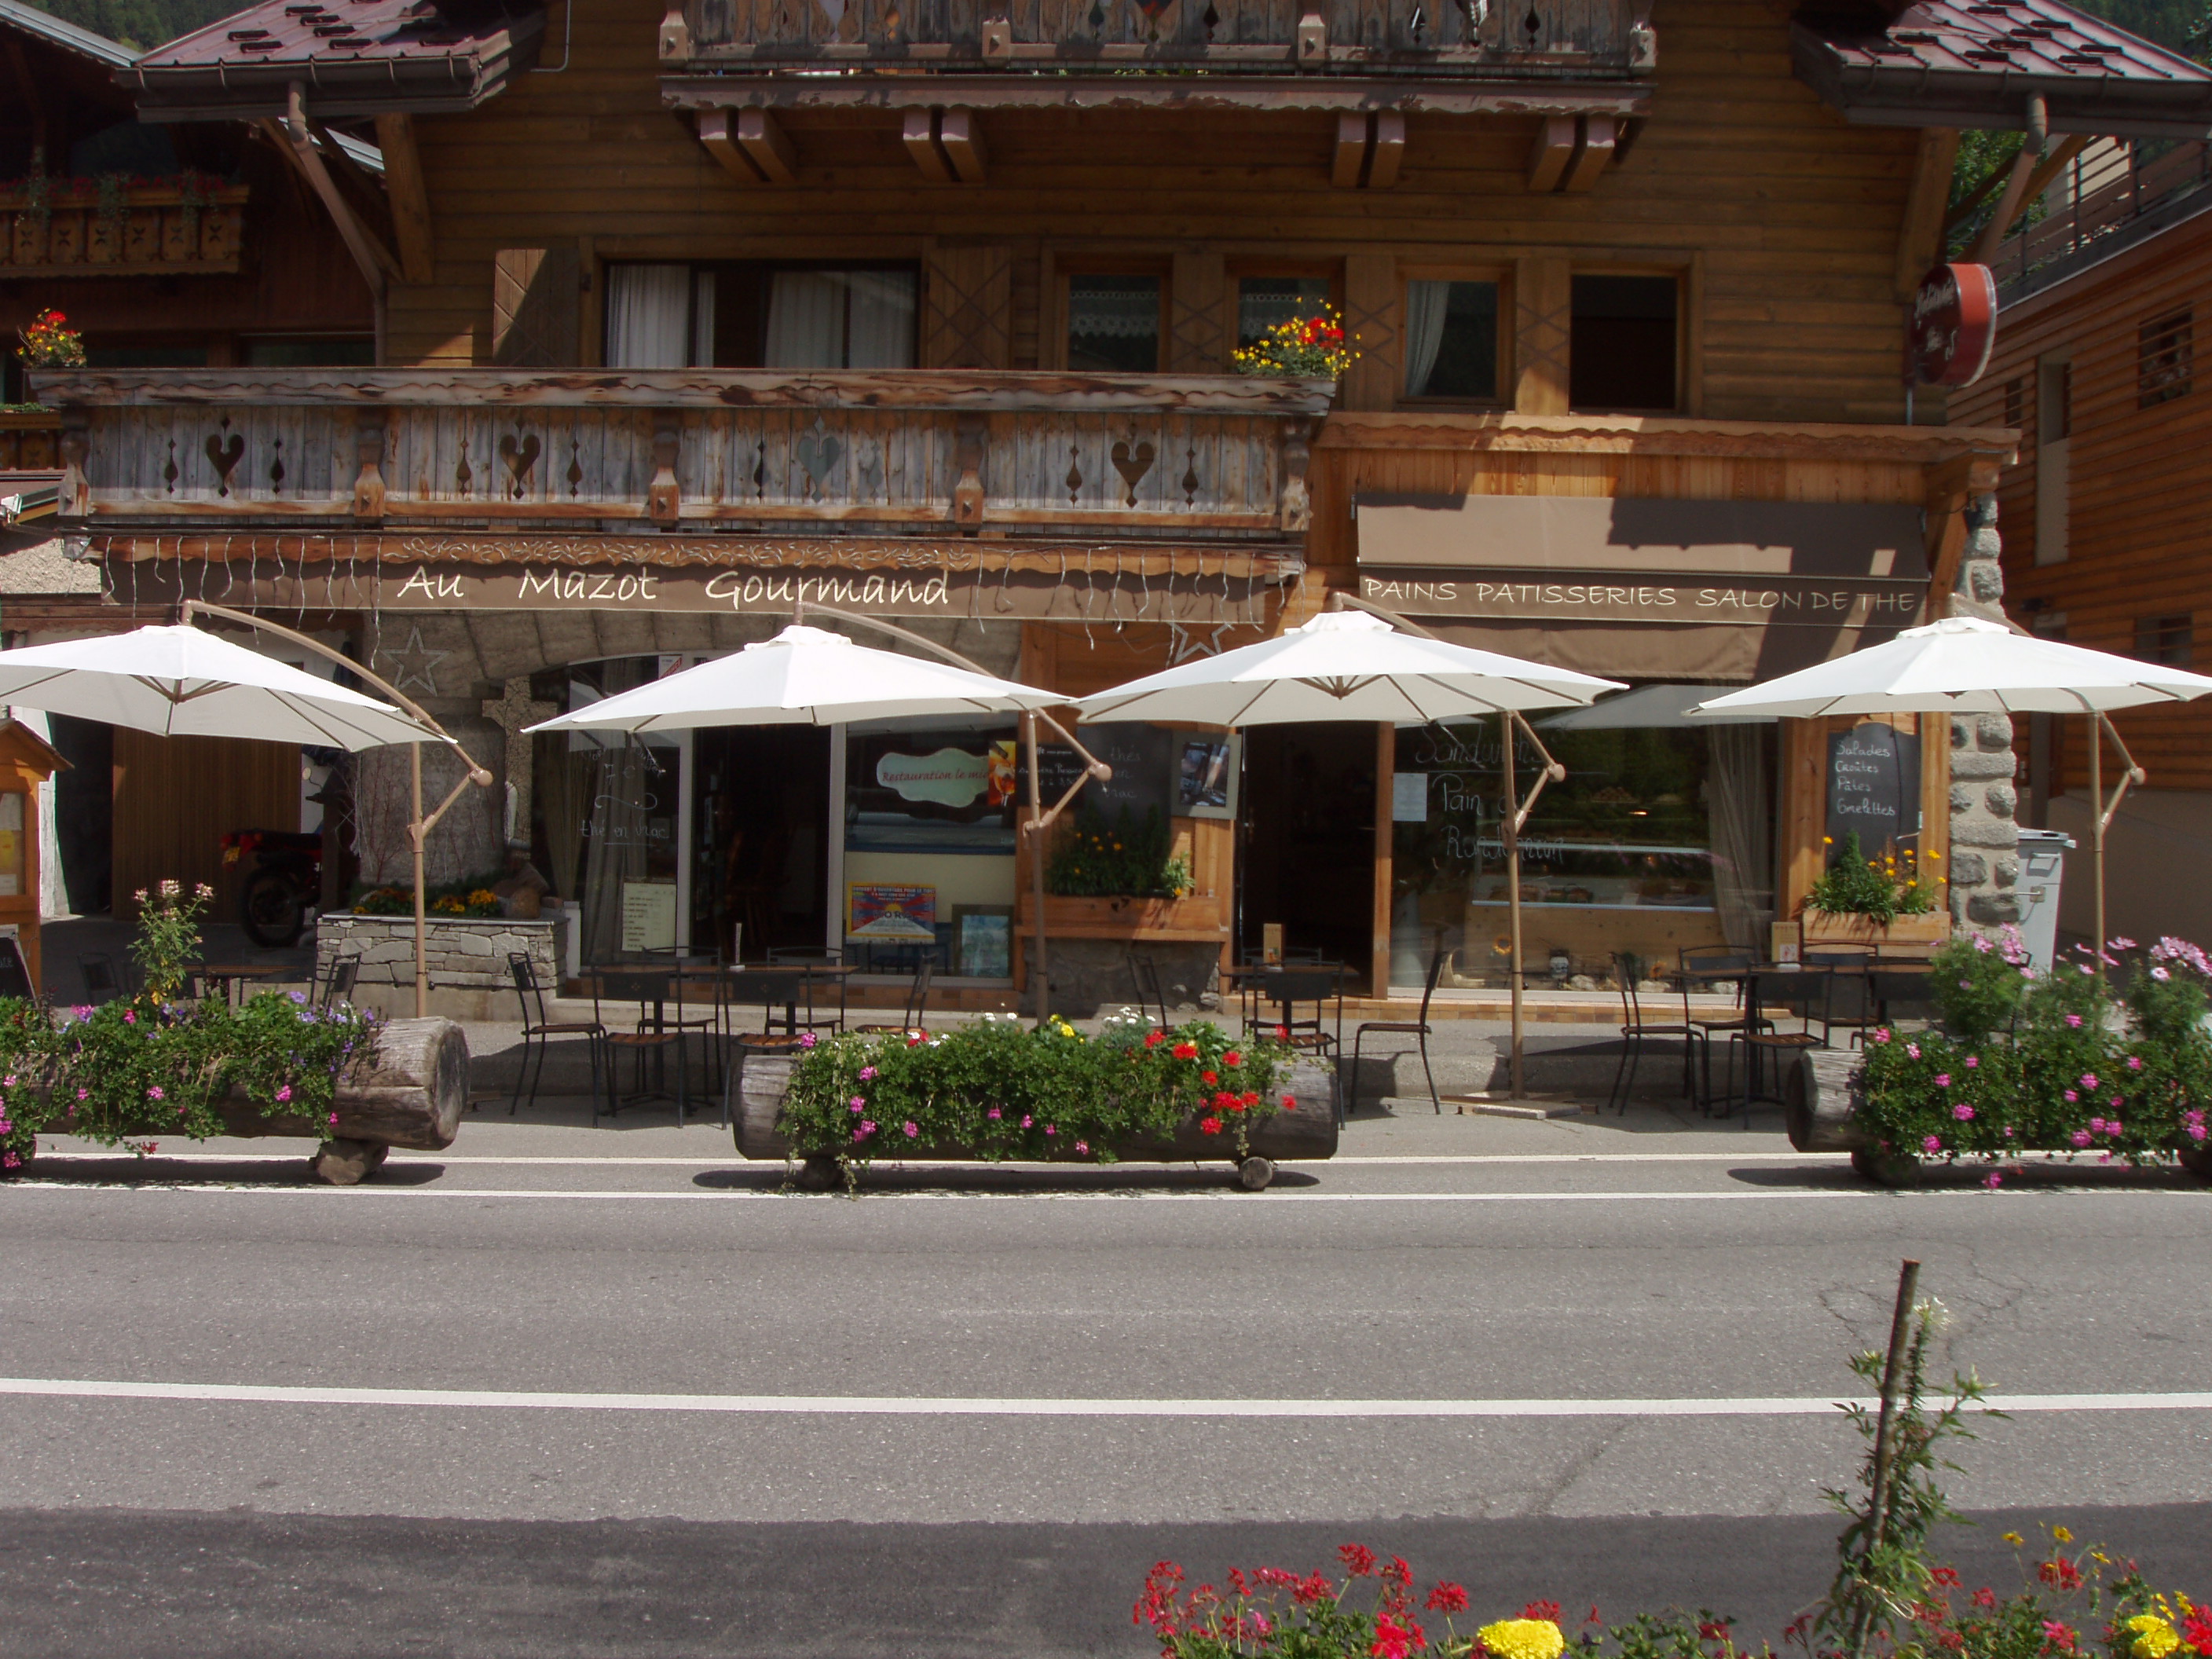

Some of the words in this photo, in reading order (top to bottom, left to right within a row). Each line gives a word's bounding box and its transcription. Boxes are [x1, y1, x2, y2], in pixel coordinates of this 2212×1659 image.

[396, 564, 465, 601] Au
[518, 568, 658, 601] Mazot
[704, 569, 950, 610] Gourmand
[1364, 578, 1457, 600] PAINS
[1475, 583, 1676, 606] PATISSERIES
[1695, 588, 1802, 610] SALON
[1811, 591, 1848, 610] DE
[1856, 592, 1915, 611] THE
[1835, 741, 1891, 757] Salades
[882, 771, 952, 782] Restauration
[955, 767, 966, 780] le
[1837, 776, 1872, 792] Pâtes
[1432, 773, 1482, 816] Pain
